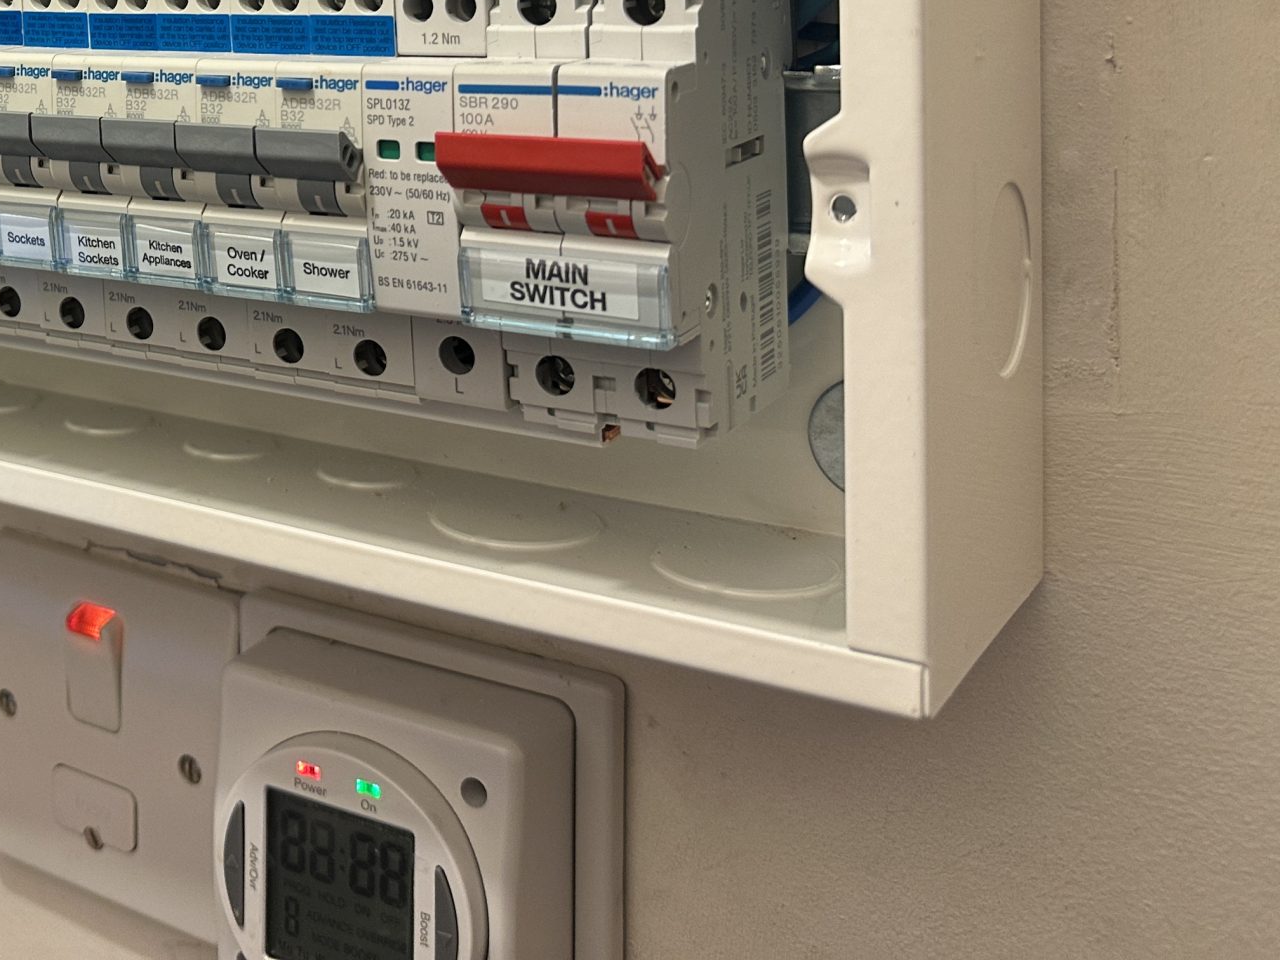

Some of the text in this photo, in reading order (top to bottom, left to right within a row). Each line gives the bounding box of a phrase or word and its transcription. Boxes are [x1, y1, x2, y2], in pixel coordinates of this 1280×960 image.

[421, 33, 460, 45] 1.2 Nm
[56, 98, 76, 108] B32
[126, 100, 147, 111] B32
[201, 104, 223, 114] B32
[366, 98, 410, 112] SPL013Z
[460, 96, 518, 110] SBR 290
[281, 110, 304, 122] B32
[366, 115, 414, 128] SPD Type 2
[368, 168, 448, 184] Red: to be replace
[406, 188, 434, 200] (50/60
[436, 191, 450, 203] Hz)
[403, 210, 415, 220] kA
[404, 224, 416, 234] kA
[8, 232, 46, 246] Sockets
[78, 236, 116, 250] Kitchen
[408, 238, 419, 248] kV
[148, 240, 182, 254] Kitchen
[227, 246, 258, 262] Oven
[78, 252, 119, 266] Sockets
[142, 252, 192, 269] Appliances
[411, 252, 417, 262] V
[227, 263, 269, 280] Cooker
[303, 262, 350, 280] Shower
[525, 258, 588, 286] MAIN
[378, 277, 448, 293] BS EN 61643-11
[510, 280, 607, 312] SWITCH
[455, 377, 464, 394] L
[294, 776, 328, 798] Power
[360, 798, 377, 813] On
[420, 911, 430, 948] Boost
